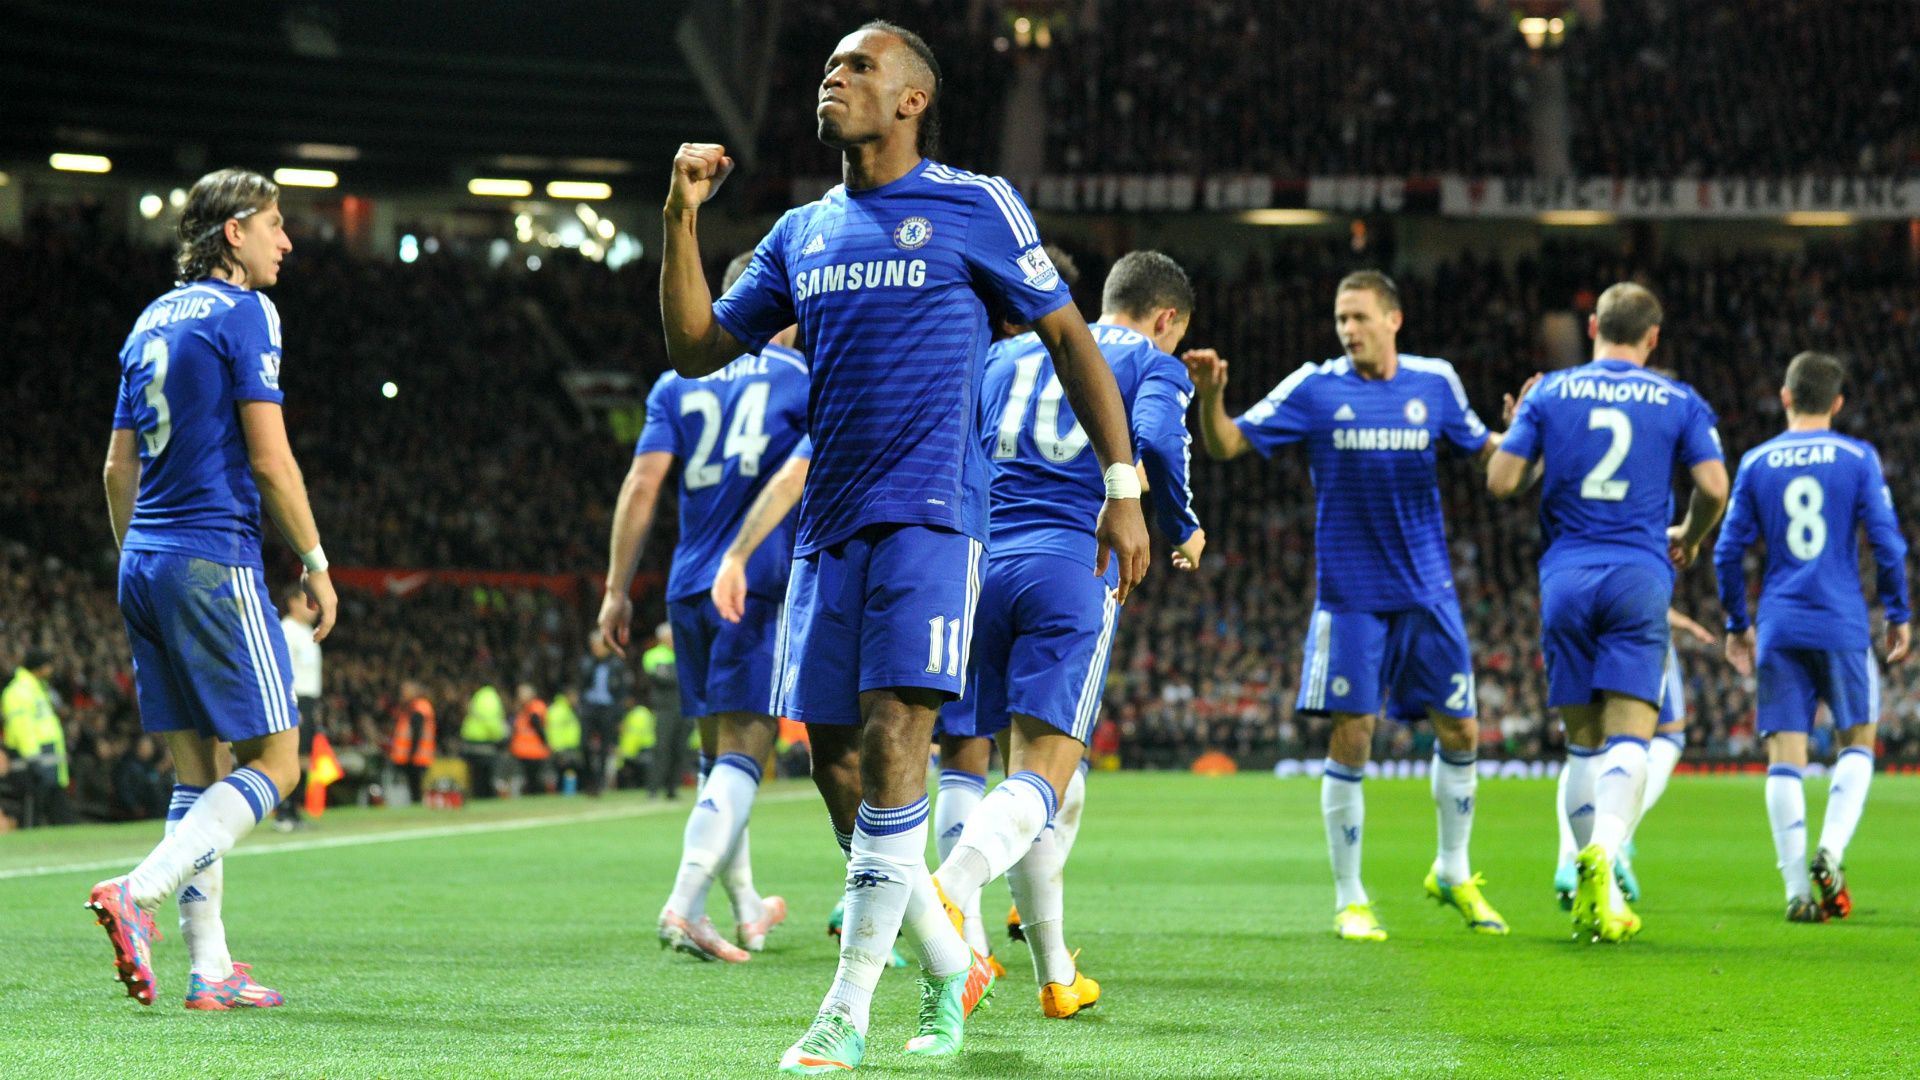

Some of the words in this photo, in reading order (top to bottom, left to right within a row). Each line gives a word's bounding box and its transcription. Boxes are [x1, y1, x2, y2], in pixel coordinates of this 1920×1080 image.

[796, 259, 927, 301] SAMSUNG
[171, 296, 216, 323] LUIS
[698, 356, 769, 382] AHILL
[141, 337, 171, 457] 3
[1560, 379, 1670, 406] IVANOVIC
[680, 381, 771, 491] 24
[1332, 428, 1429, 451] SAMSUNG
[1580, 408, 1632, 501] 2
[1767, 446, 1836, 468] OSCAR
[1783, 475, 1827, 561] 8
[925, 615, 960, 677] 11
